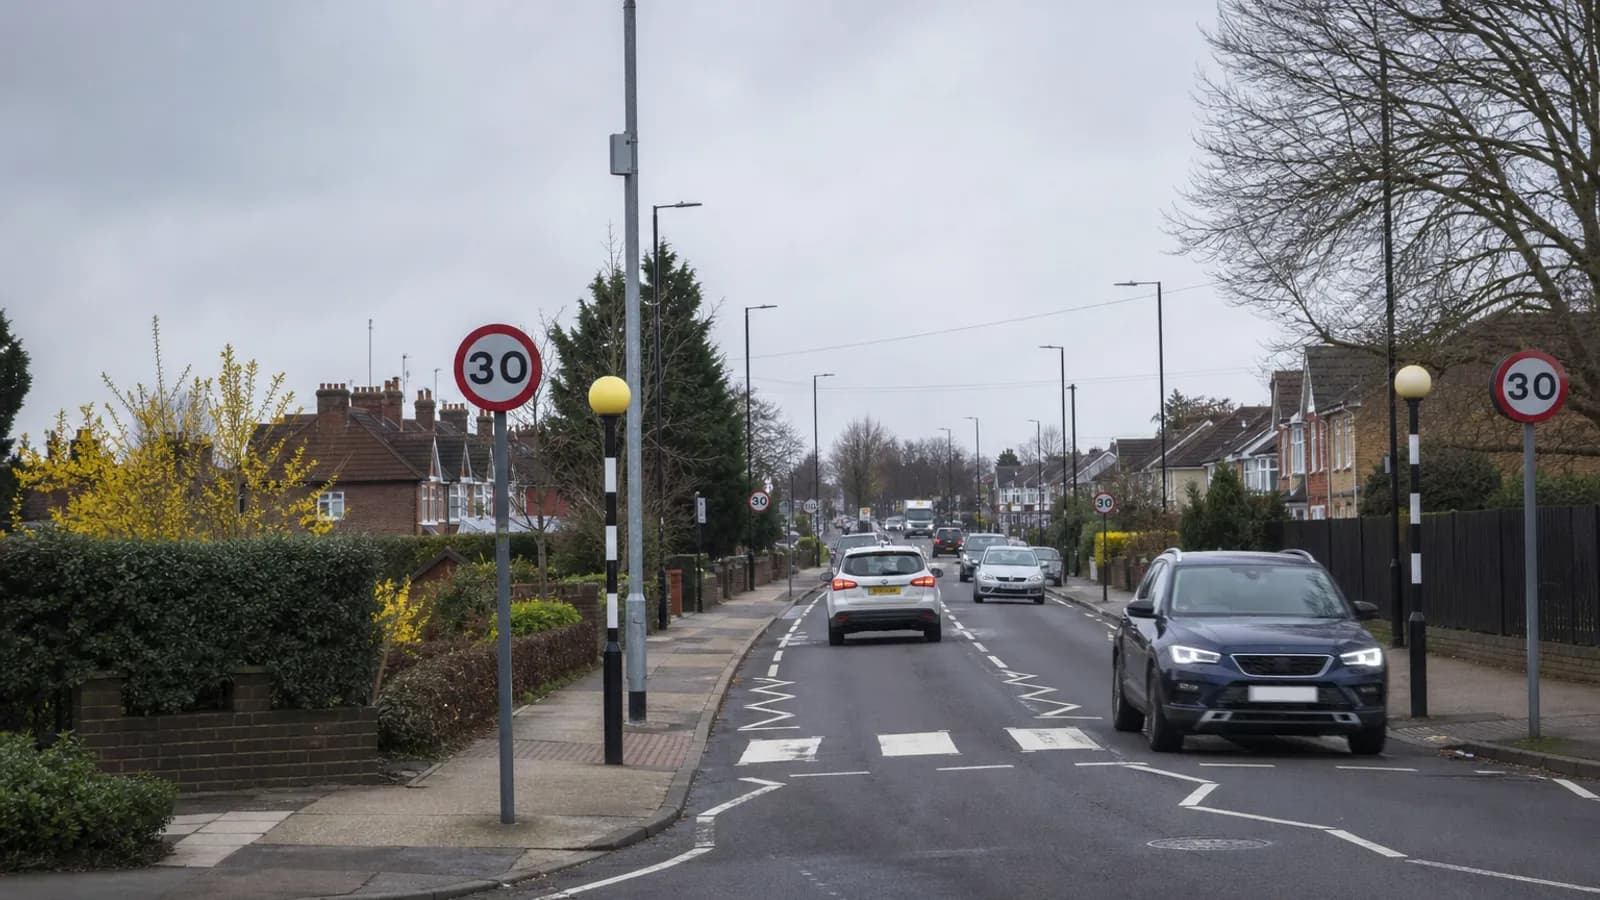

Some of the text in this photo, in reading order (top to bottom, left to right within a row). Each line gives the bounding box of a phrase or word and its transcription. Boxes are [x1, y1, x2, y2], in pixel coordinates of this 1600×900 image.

[468, 351, 528, 385] 30
[1507, 372, 1557, 400] 30
[752, 496, 768, 506] 30
[1097, 498, 1112, 508] 30
